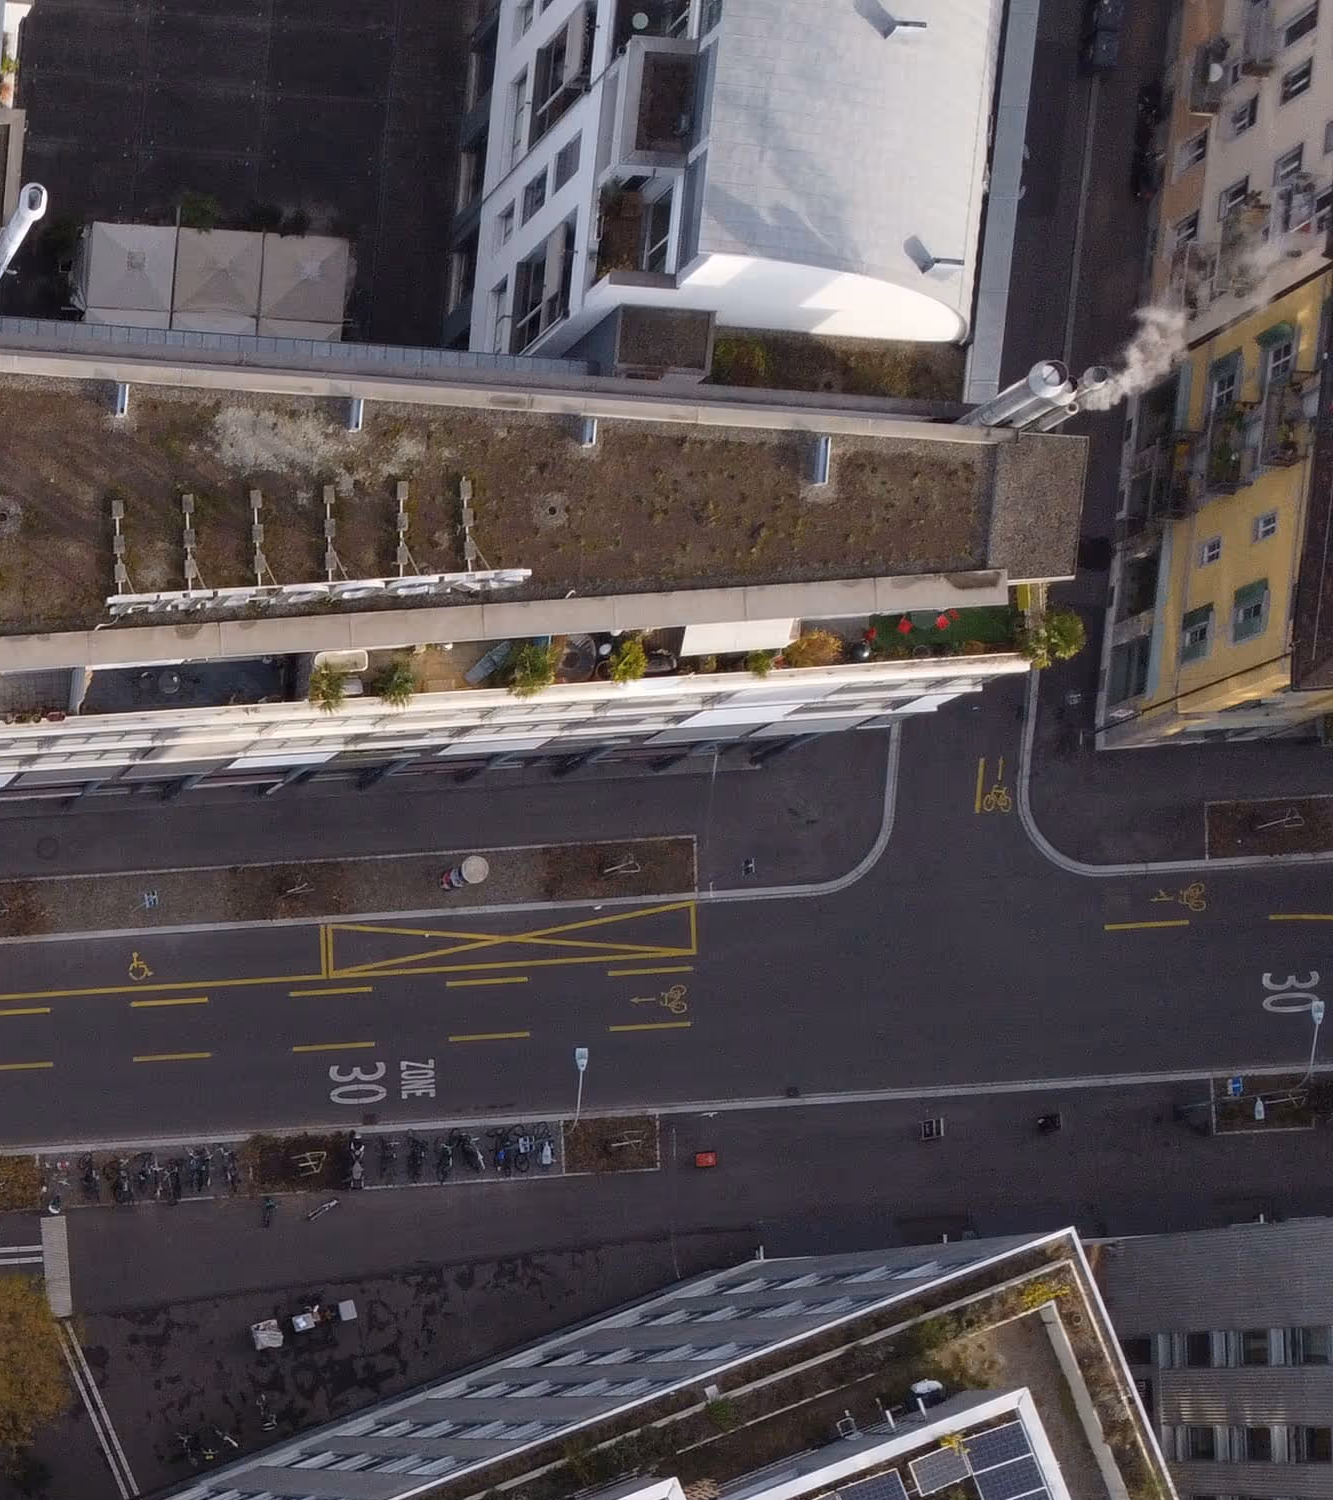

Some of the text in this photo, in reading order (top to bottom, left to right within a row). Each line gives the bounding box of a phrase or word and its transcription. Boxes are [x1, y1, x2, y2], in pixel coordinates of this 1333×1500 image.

[1262, 970, 1321, 1013] 30
[328, 1061, 388, 1105] 30
[399, 1058, 437, 1100] ZONE
